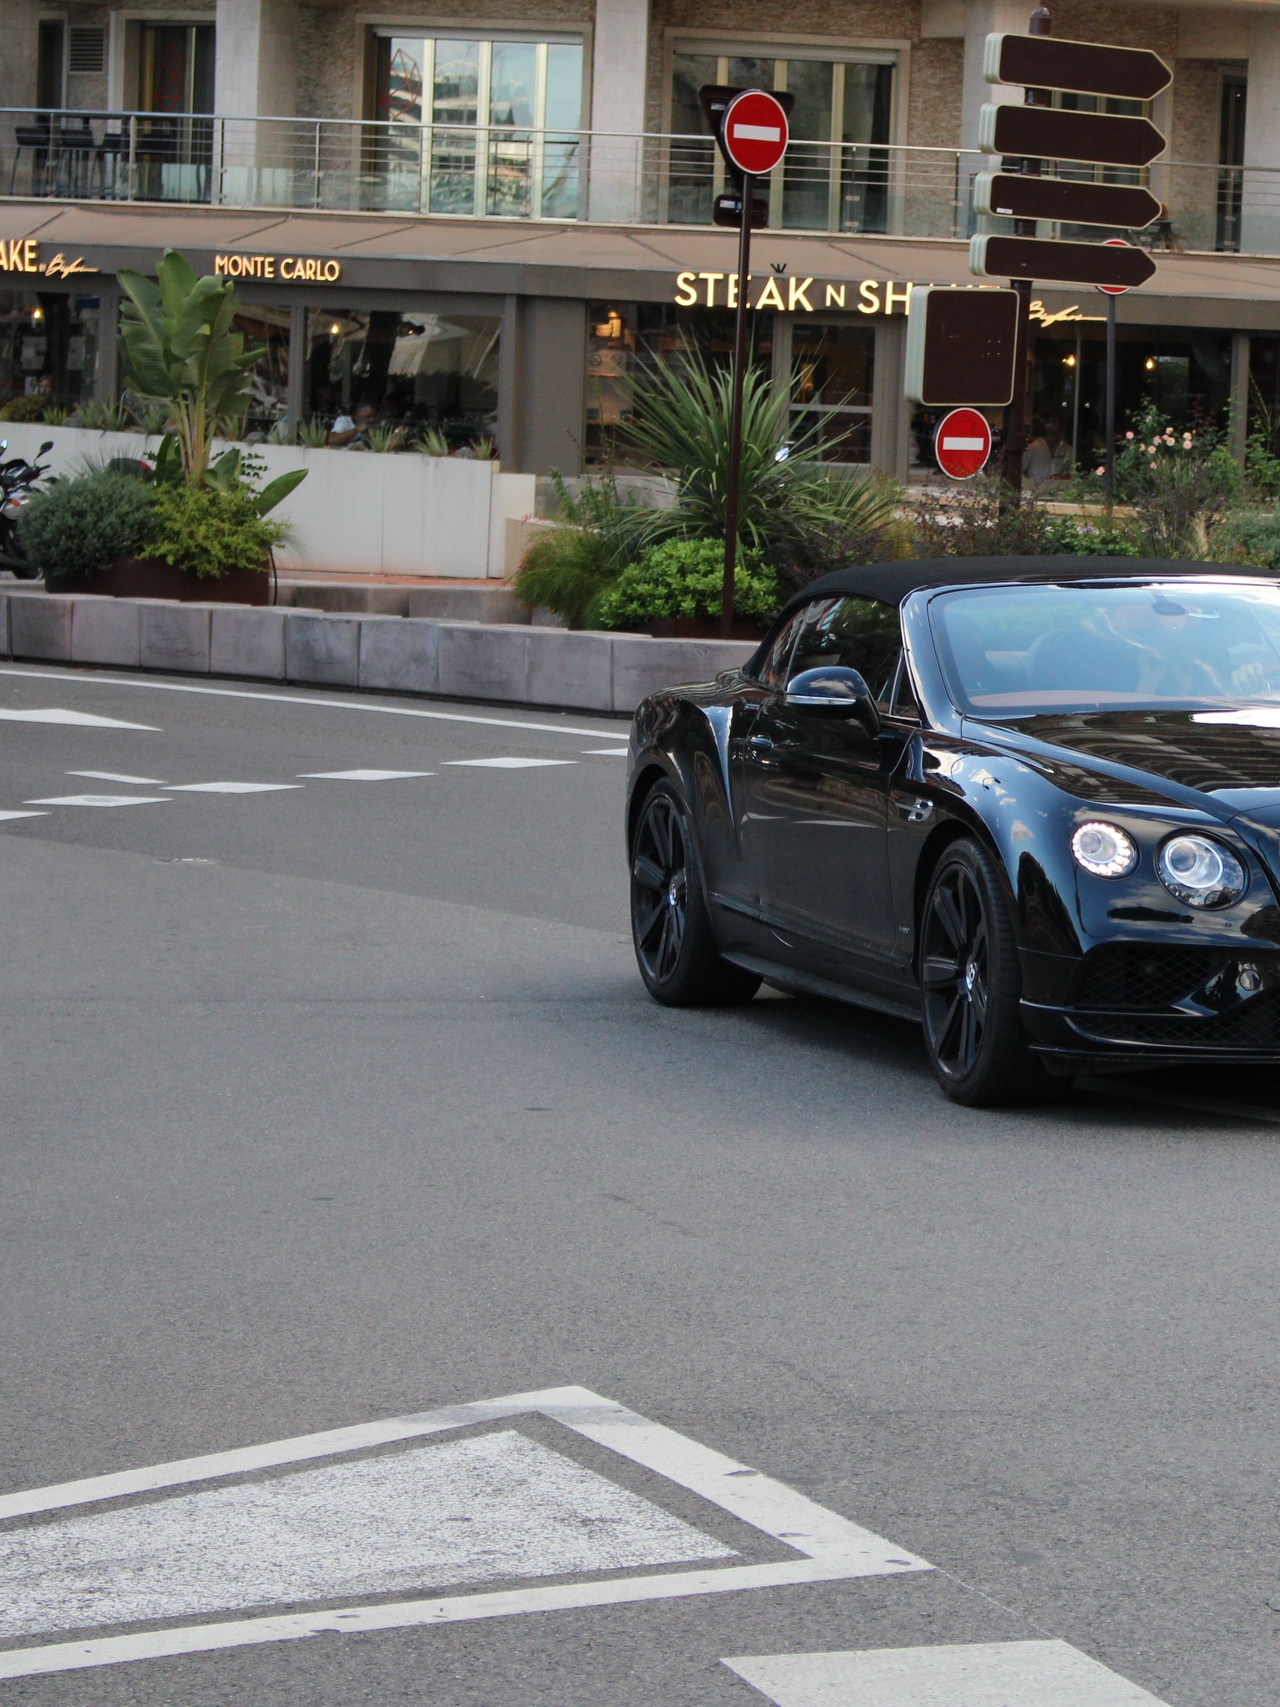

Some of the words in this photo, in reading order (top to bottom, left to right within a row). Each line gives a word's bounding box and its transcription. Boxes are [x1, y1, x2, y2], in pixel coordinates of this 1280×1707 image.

[214, 255, 275, 278] MONTE
[280, 258, 340, 281] CARLO
[674, 271, 814, 312] STEAK
[825, 284, 846, 308] N
